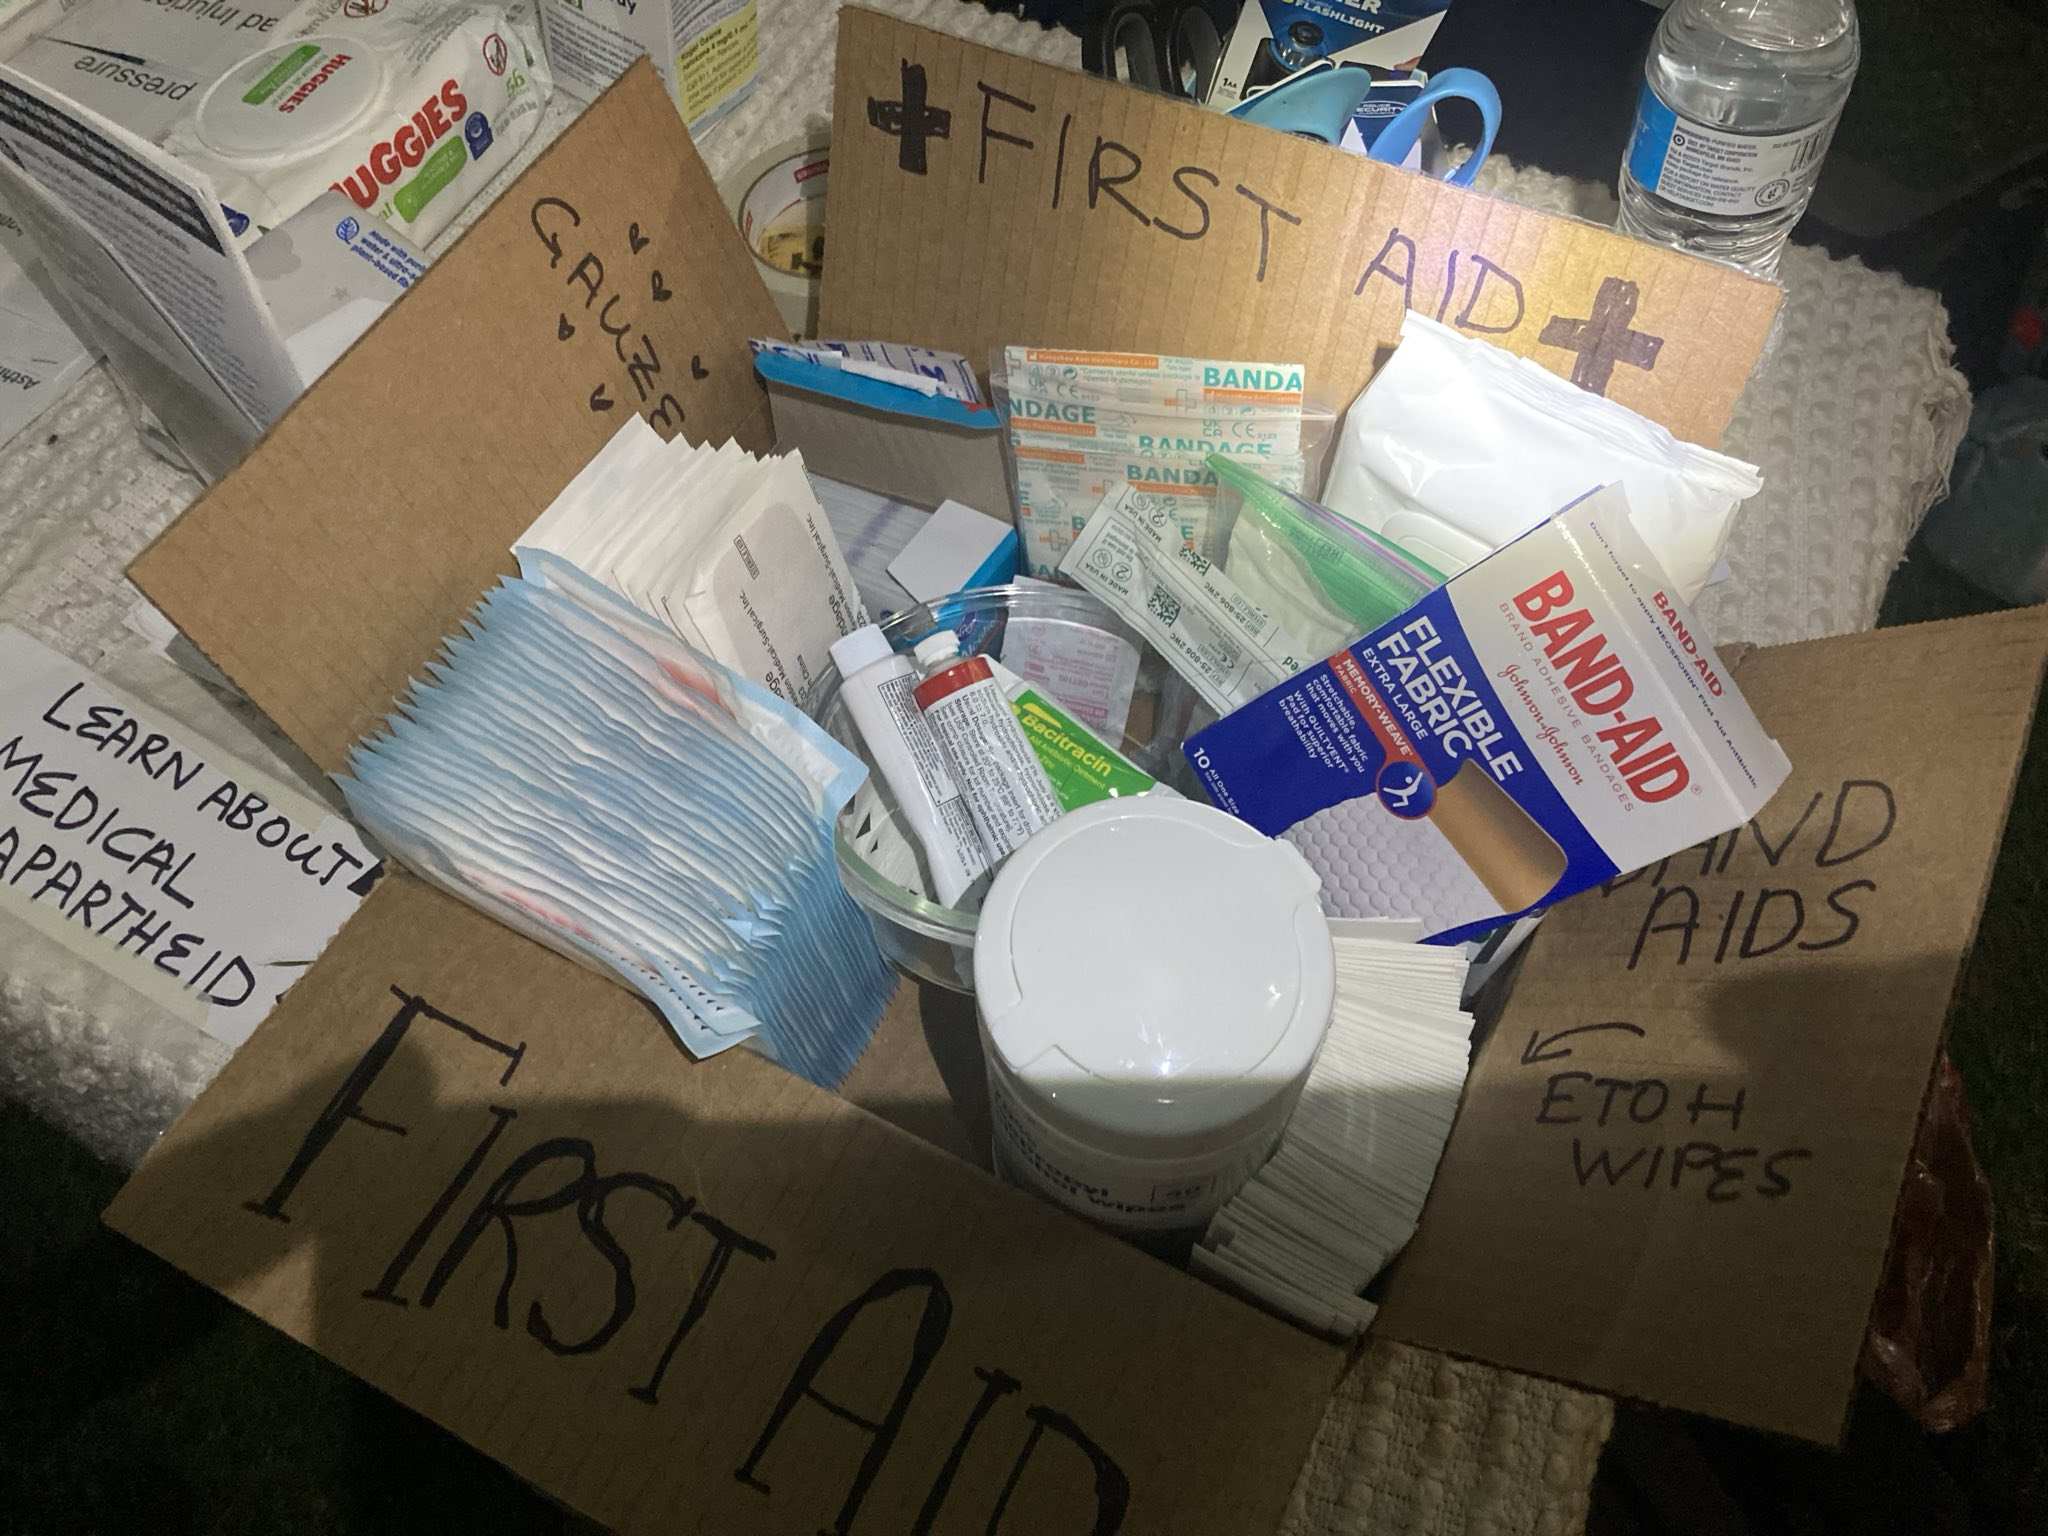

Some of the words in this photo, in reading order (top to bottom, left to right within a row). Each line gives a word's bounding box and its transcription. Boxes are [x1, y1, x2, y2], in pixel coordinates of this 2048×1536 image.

[1294, 0, 1385, 34] FLASHLIGHT
[75, 54, 197, 101] pressure
[279, 54, 352, 114] HUGGIES
[328, 79, 467, 209] UGGIES
[977, 81, 1301, 282] FIRST
[1354, 227, 1525, 335] AID
[802, 512, 817, 532] Inc.
[1122, 502, 1139, 519] USA
[1136, 515, 1146, 526] IN
[1143, 523, 1163, 543] MADE
[809, 530, 849, 603] Medical-Surgical
[1083, 560, 1101, 575] USA
[1098, 572, 1108, 581] IN
[1107, 576, 1129, 595] MADE
[1202, 580, 1220, 599] 2WC
[737, 589, 751, 607] Inc.
[823, 593, 852, 637] ndage
[744, 605, 788, 679] Medical-Surgical
[794, 653, 811, 679] China
[1168, 630, 1186, 649] 2WC
[1651, 590, 1726, 699] BAND-AID
[1291, 690, 1311, 715] With
[1317, 672, 1359, 730] Stretchable,
[1333, 664, 1357, 694] FABRIC
[1361, 646, 1397, 694] EXTRA
[1392, 692, 1428, 741] LARGE
[1377, 632, 1473, 759] FABRIC
[1403, 615, 1523, 782] FLEXIBLE
[1497, 601, 1534, 653] BRAND
[1530, 654, 1582, 730] ADHESIVE
[1580, 733, 1635, 814] BANDAGES
[945, 720, 959, 740] crimp
[952, 698, 972, 729] Storage:
[968, 729, 981, 748] Store
[975, 688, 992, 714] sodium
[1005, 748, 1020, 771] and/or
[1020, 710, 1113, 777] Bacitracin
[1274, 698, 1320, 760] breathability
[1284, 694, 1301, 714] Pad
[1296, 713, 1310, 729] for
[1304, 728, 1335, 770] superior
[1304, 682, 1321, 703] that
[1316, 702, 1339, 733] moves
[1336, 732, 1354, 754] with
[1349, 754, 1365, 774] you
[1310, 677, 1351, 734] comfortable
[1347, 733, 1369, 762] fabric
[933, 708, 943, 722] For
[938, 722, 954, 746] topical
[950, 746, 960, 760] use
[965, 778, 975, 792] Not
[971, 791, 981, 803] for
[976, 803, 999, 842] ophthalmic
[995, 842, 1007, 857] use.
[953, 716, 965, 732] USP
[960, 732, 981, 767] Controlled
[976, 766, 990, 787] Room
[955, 740, 971, 765] closure
[968, 765, 977, 776] for
[970, 715, 991, 746] Dosage:
[991, 759, 1011, 790] package
[1008, 789, 1022, 809] insert
[1018, 809, 1027, 820] for
[972, 775, 981, 786] lot
[1191, 746, 1212, 770] 10
[1209, 767, 1219, 780] All
[1216, 779, 1229, 797] One
[1226, 796, 1240, 815] Size
[43, 682, 204, 790] LEARN
[197, 781, 363, 886] ABOUT
[977, 786, 995, 813] number
[0, 735, 196, 909] MEDICAL
[991, 813, 1001, 826] and
[0, 826, 256, 1007] APARTHEID
[1628, 879, 1876, 970] AIDS
[242, 984, 777, 1404] FIRST
[1572, 1137, 1812, 1202] WIPES
[733, 1266, 1131, 1536] AID
